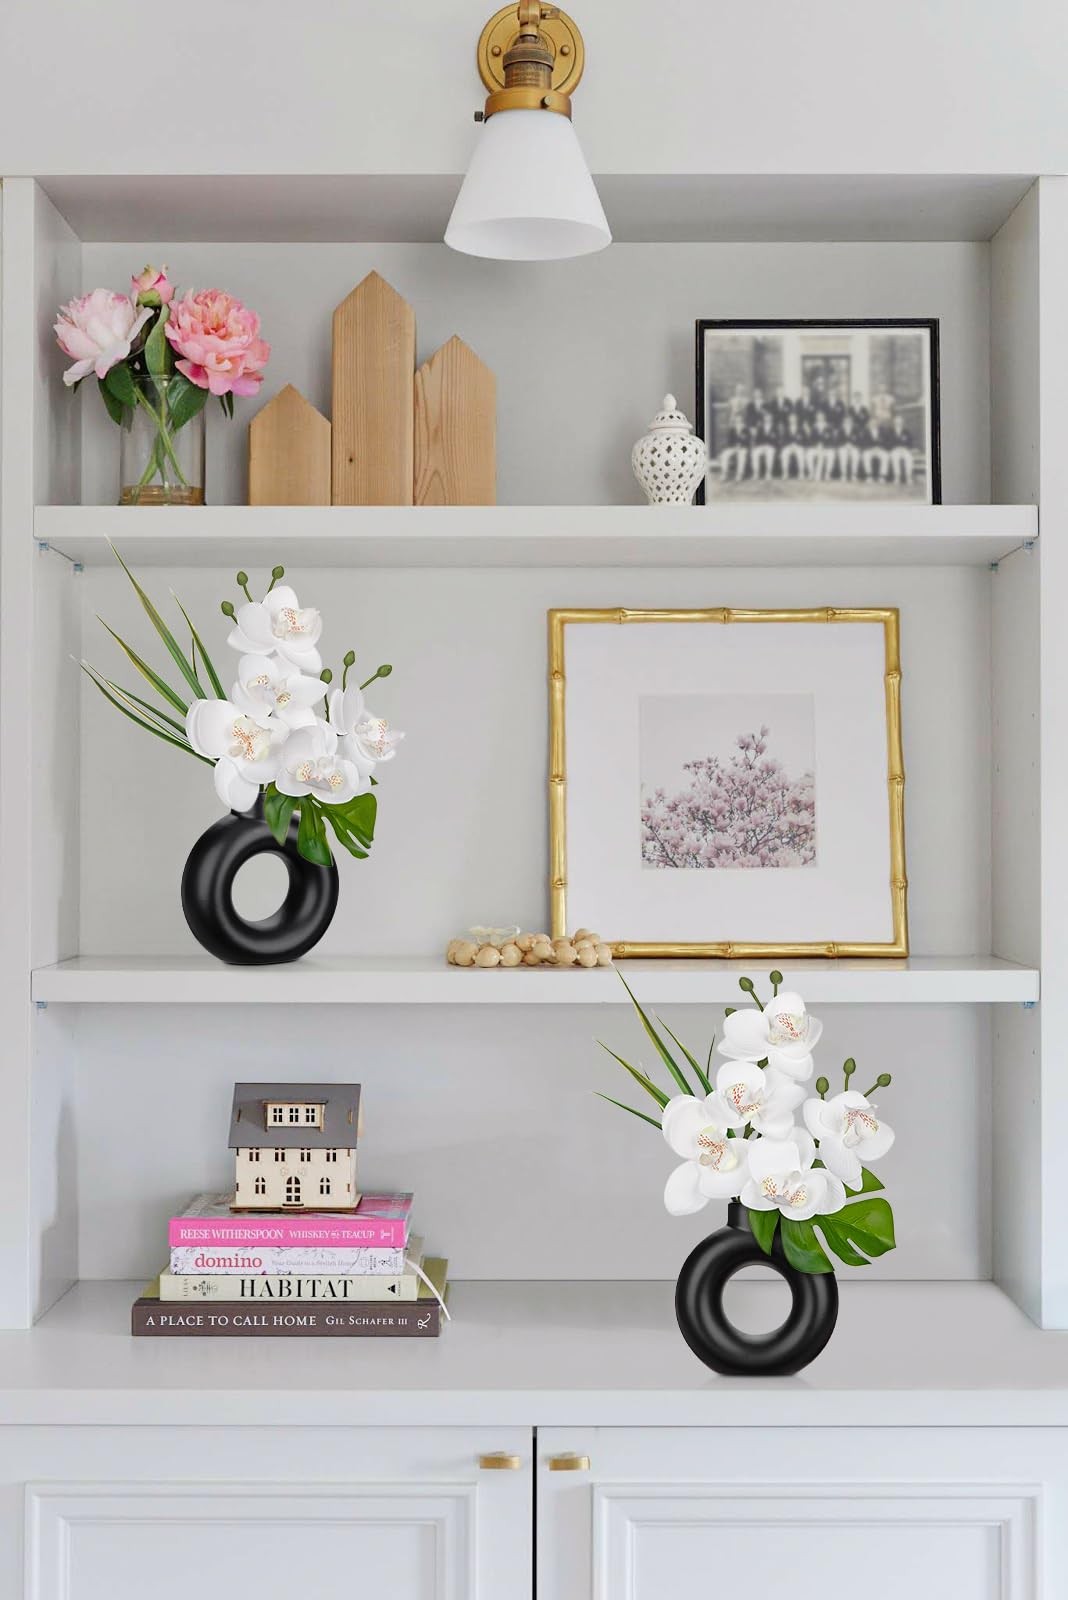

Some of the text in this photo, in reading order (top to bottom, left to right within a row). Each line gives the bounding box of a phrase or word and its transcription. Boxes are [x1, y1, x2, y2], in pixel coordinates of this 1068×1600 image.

[180, 1228, 284, 1239] REESE WITHERSPOON
[289, 1229, 330, 1239] WHISKEY
[341, 1229, 375, 1239] TEACUP
[194, 1253, 263, 1268] domino
[239, 1279, 354, 1298] HABITAT
[146, 1315, 317, 1326] A PLACE TO CALL HOME
